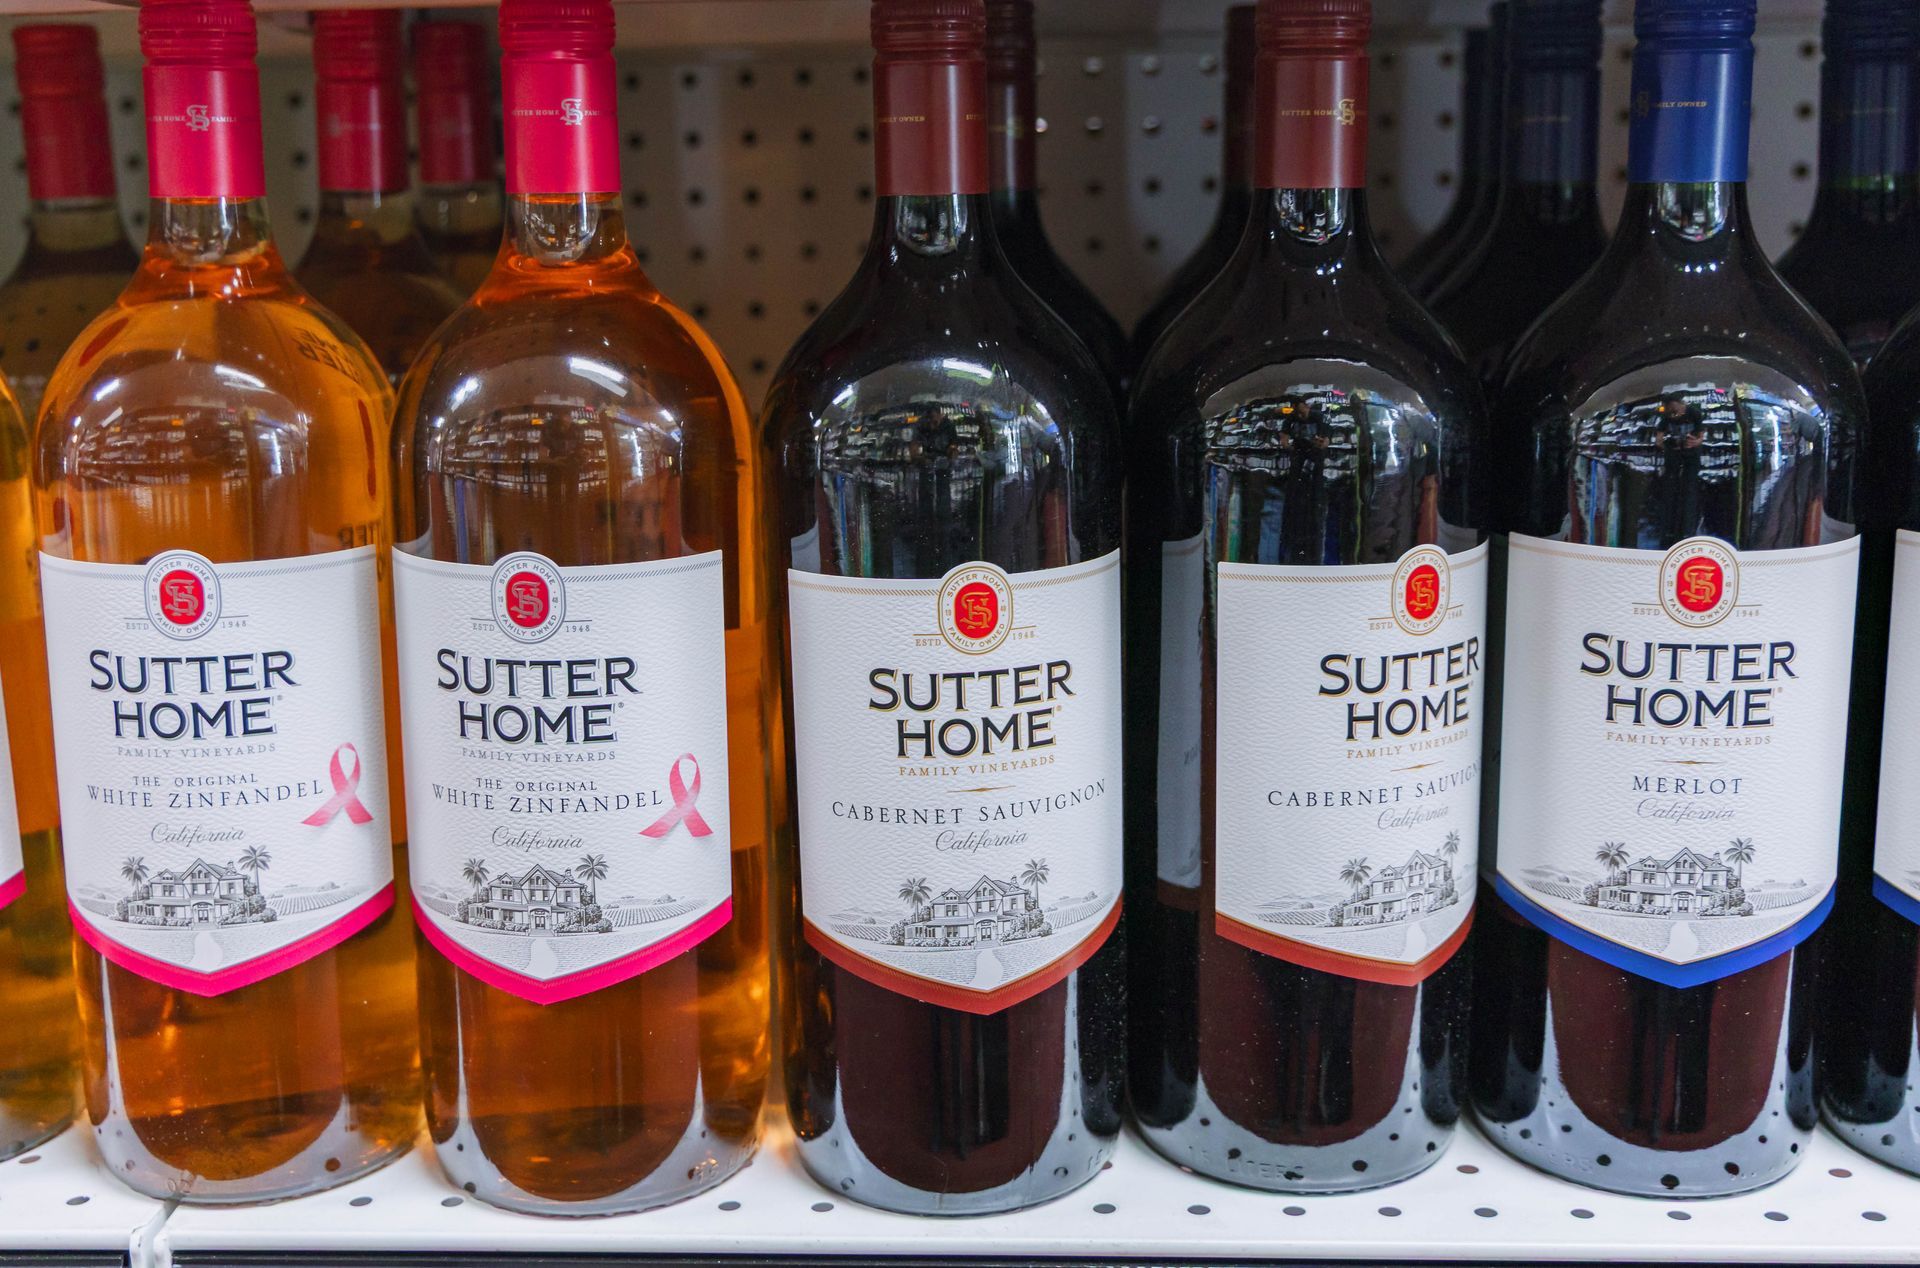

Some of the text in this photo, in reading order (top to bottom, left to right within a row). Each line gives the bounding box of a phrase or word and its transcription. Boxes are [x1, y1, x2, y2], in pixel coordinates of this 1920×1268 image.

[1633, 607, 1660, 616] ESTD
[126, 622, 149, 630] ESTD
[472, 623, 495, 631] ESTD
[1369, 621, 1393, 631] ESTD
[915, 638, 942, 647] ESTD
[1318, 636, 1480, 697] SUTTER
[1579, 632, 1800, 683] SUTTER
[89, 649, 301, 695] SUTTER
[436, 648, 644, 699] SUTTER
[868, 659, 1077, 713] SUTTER
[117, 743, 277, 758] FAMILY VINEYARDS
[1606, 731, 1772, 748] FAMILY VINEYARDS
[462, 748, 616, 764] FAMILY VINEYARDS
[1346, 745, 1402, 760] FAMILY
[899, 754, 1056, 777] FAMILY VINEYARDS
[133, 773, 259, 787] THE ORIGINAL
[476, 777, 598, 792] THE ORIGINAL
[1632, 775, 1743, 794] MERLOT
[87, 779, 324, 809] WHITE ZINFANDEL
[432, 783, 663, 814] WHITE ZINFANDEL
[831, 778, 1105, 825] CABERNET SAUVIGNON
[1267, 785, 1403, 808] CABERNET
[1376, 804, 1449, 830] California
[1636, 798, 1735, 823] California
[150, 822, 245, 847] California
[491, 825, 585, 852] California
[935, 828, 1030, 854] California
